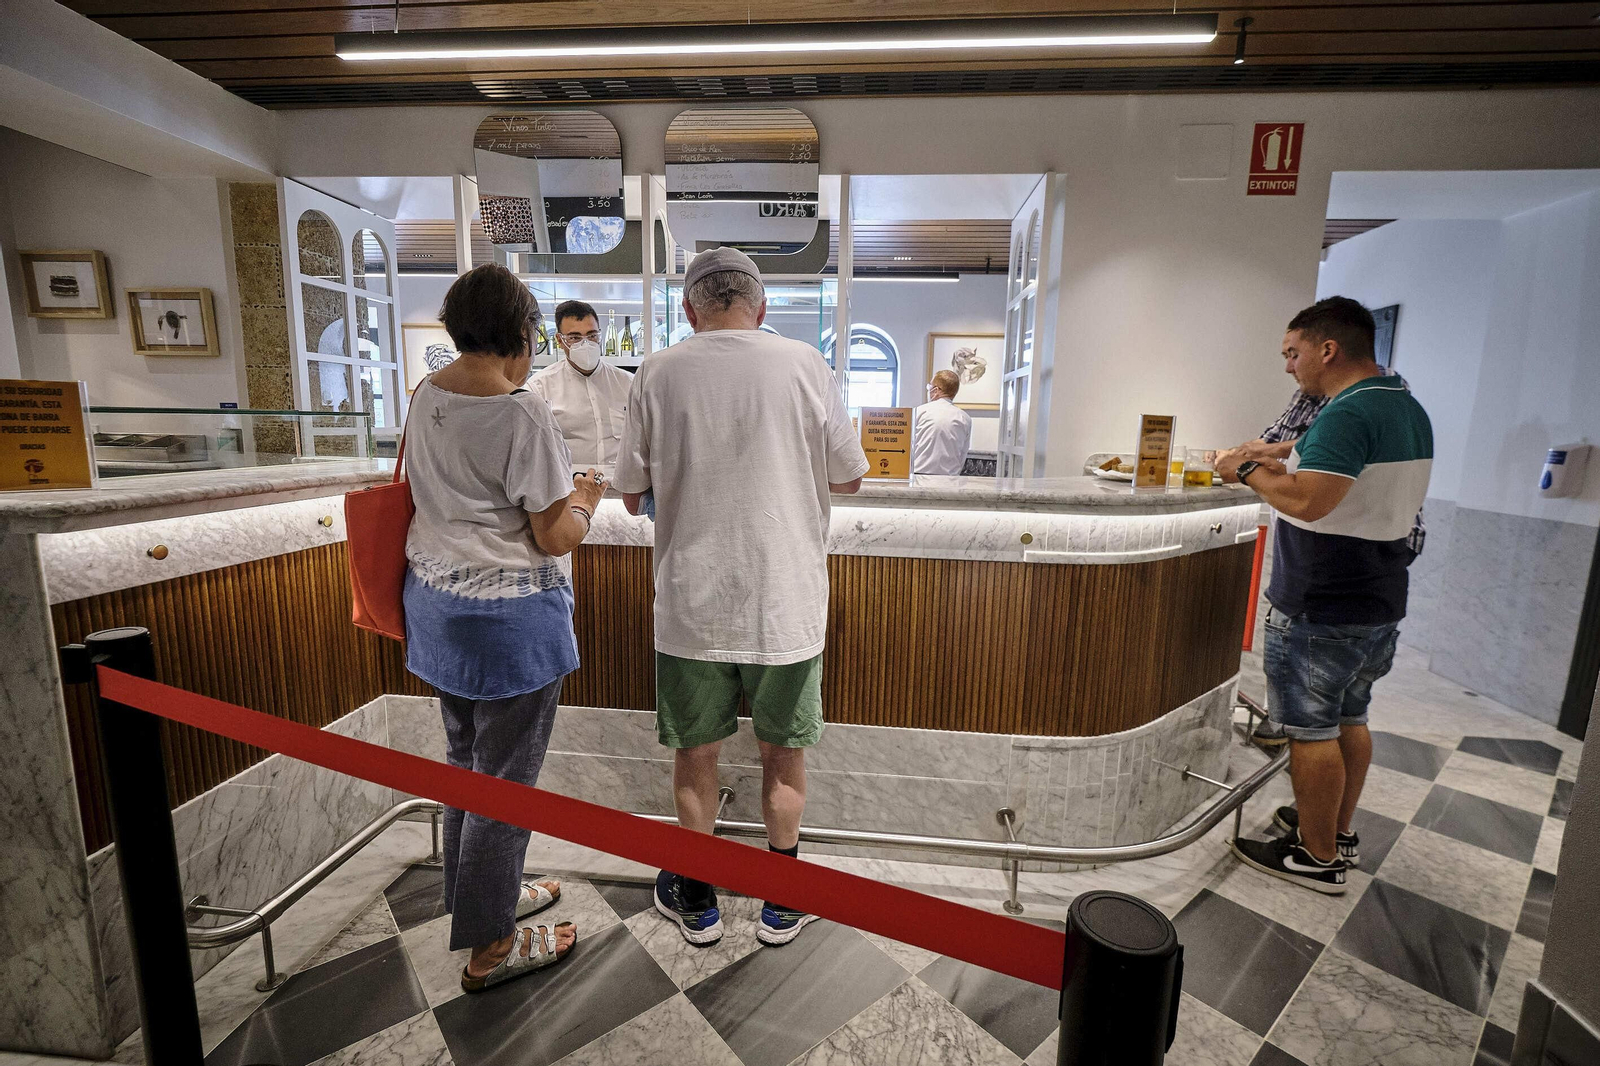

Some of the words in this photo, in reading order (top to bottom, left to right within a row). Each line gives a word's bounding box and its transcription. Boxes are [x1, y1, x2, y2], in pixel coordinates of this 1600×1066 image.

[502, 115, 529, 132] Vinos
[1249, 180, 1296, 190] EXTINTOR
[587, 200, 611, 209] 3.50
[17, 387, 63, 396] SEGURIDAD
[42, 401, 62, 409] ESTA
[20, 412, 31, 421] DE
[33, 413, 60, 421] BARRA
[1, 425, 28, 434] PUEDE
[30, 426, 72, 434] OCUPARSE
